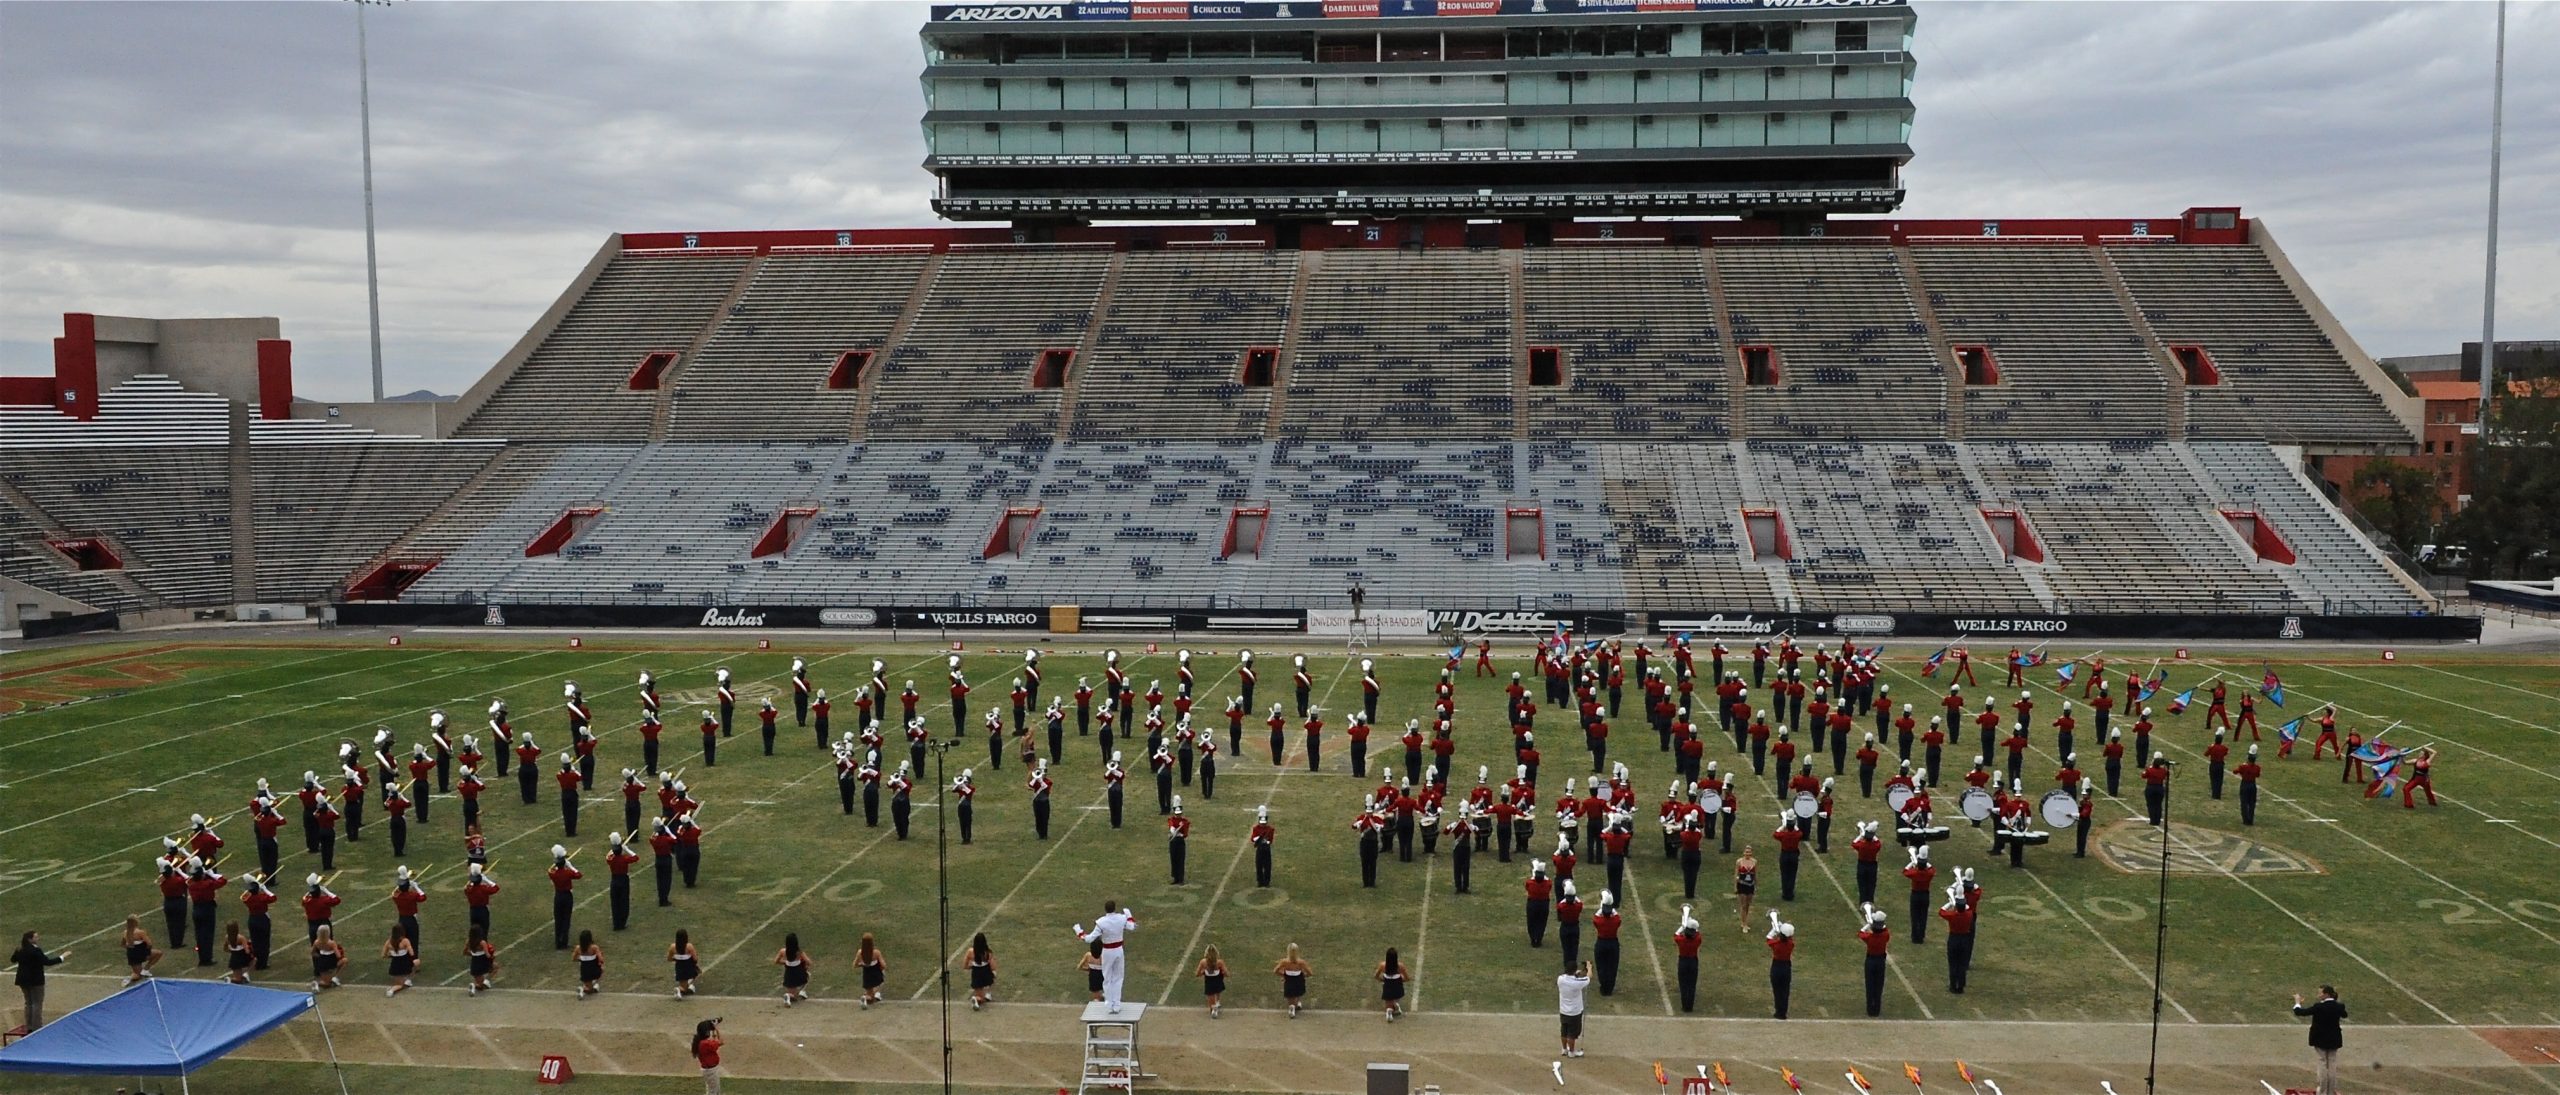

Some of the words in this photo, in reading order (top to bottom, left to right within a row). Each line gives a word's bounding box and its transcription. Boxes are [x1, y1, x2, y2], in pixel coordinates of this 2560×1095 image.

[1078, 7, 1086, 15] 22
[1086, 8, 1099, 16] ART
[1100, 6, 1128, 15] LUPPINO
[1323, 4, 1328, 12] 4
[944, 6, 1062, 20] ARIZONA
[1214, 232, 1226, 240] 20
[1368, 231, 1378, 240] 21
[1600, 230, 1613, 238] 22
[1810, 228, 1823, 236] 23
[1984, 227, 1997, 236] 24
[2134, 227, 2146, 236] 25
[838, 237, 850, 246] 18
[1014, 234, 1024, 243] 19
[686, 239, 696, 248] 17
[64, 392, 76, 400] 15
[328, 407, 339, 416] 16
[484, 606, 504, 625] A
[700, 608, 766, 626] Bashas'
[931, 613, 984, 624] WELLS
[986, 614, 1037, 624] FARGO
[1310, 617, 1346, 626] UNIVERSITY
[1358, 618, 1388, 627] IZONA
[1390, 618, 1408, 627] BAND
[1410, 618, 1424, 627] DAY
[1954, 620, 2010, 632] WELLS
[2013, 620, 2068, 632] FARGO
[2280, 617, 2304, 638] A
[542, 1060, 560, 1080] 40
